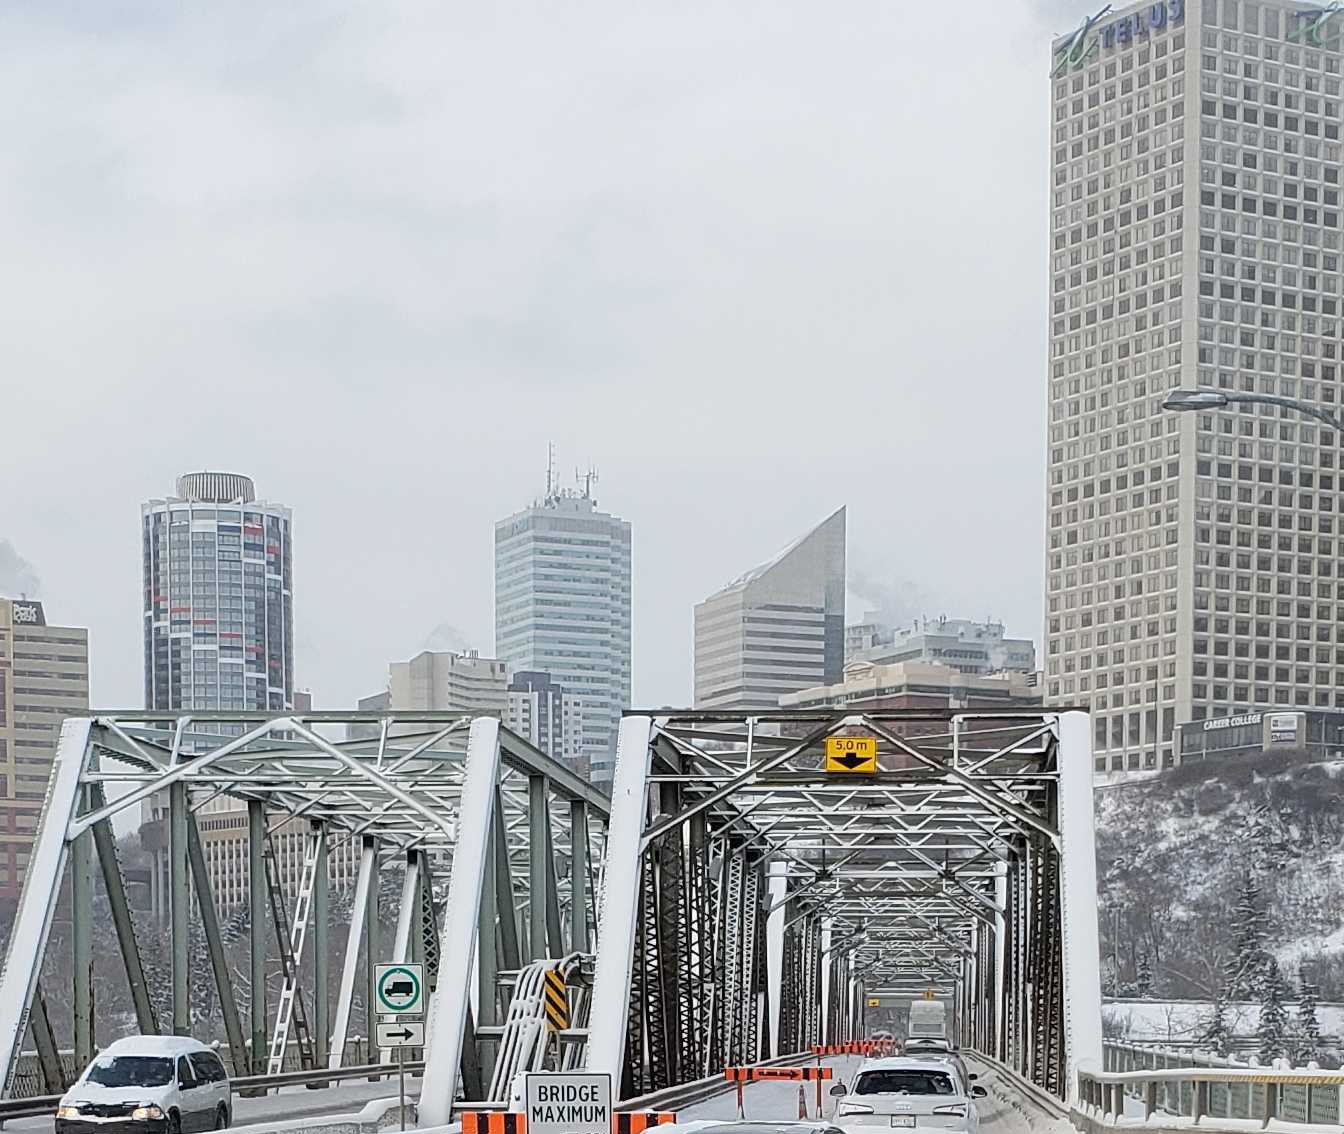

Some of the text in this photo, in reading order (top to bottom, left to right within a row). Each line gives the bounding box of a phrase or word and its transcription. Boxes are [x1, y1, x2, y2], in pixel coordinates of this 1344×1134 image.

[1099, 0, 1184, 48] TELUS
[1203, 719, 1230, 731] CAREER
[1231, 714, 1262, 727] COLLEGE
[836, 740, 867, 751] 5.0 m
[538, 1085, 599, 1102] BRIDGE
[532, 1106, 606, 1123] MAXIMUM
